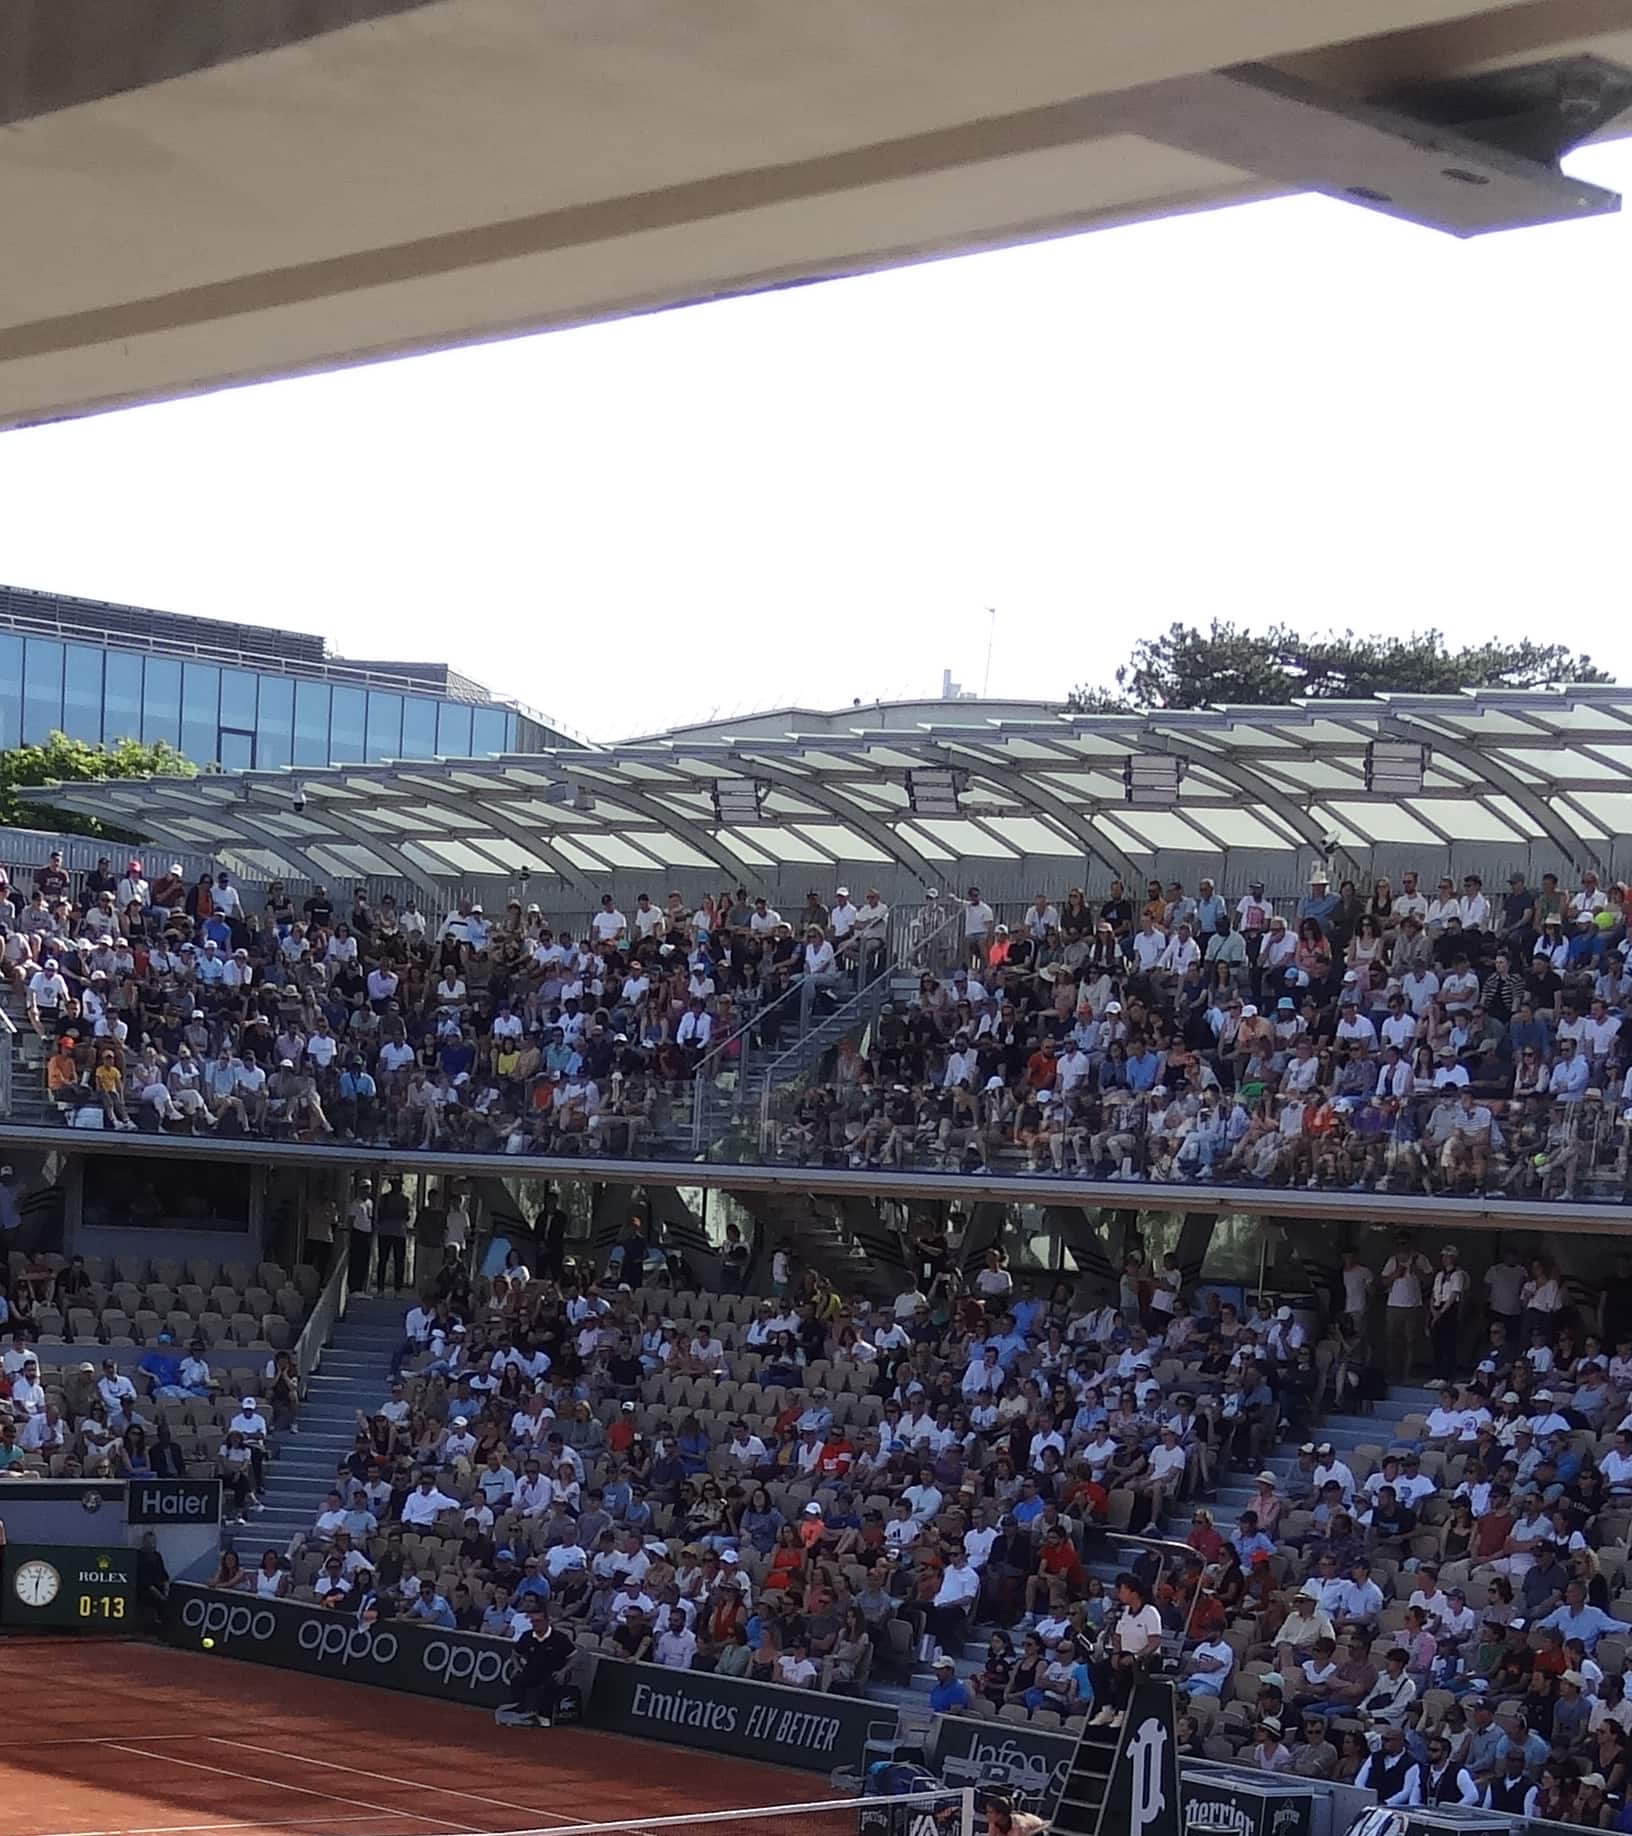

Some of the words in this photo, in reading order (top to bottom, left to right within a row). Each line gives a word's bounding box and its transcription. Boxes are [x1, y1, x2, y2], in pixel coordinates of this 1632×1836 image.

[141, 1489, 209, 1515] Haier
[79, 1571, 129, 1584] ROLEX
[79, 1595, 125, 1618] 0:13
[181, 1598, 276, 1643] oppo
[298, 1619, 398, 1664] oppo
[631, 1683, 738, 1732] Emirates
[744, 1704, 777, 1740] FLY
[775, 1709, 841, 1752] BETTER
